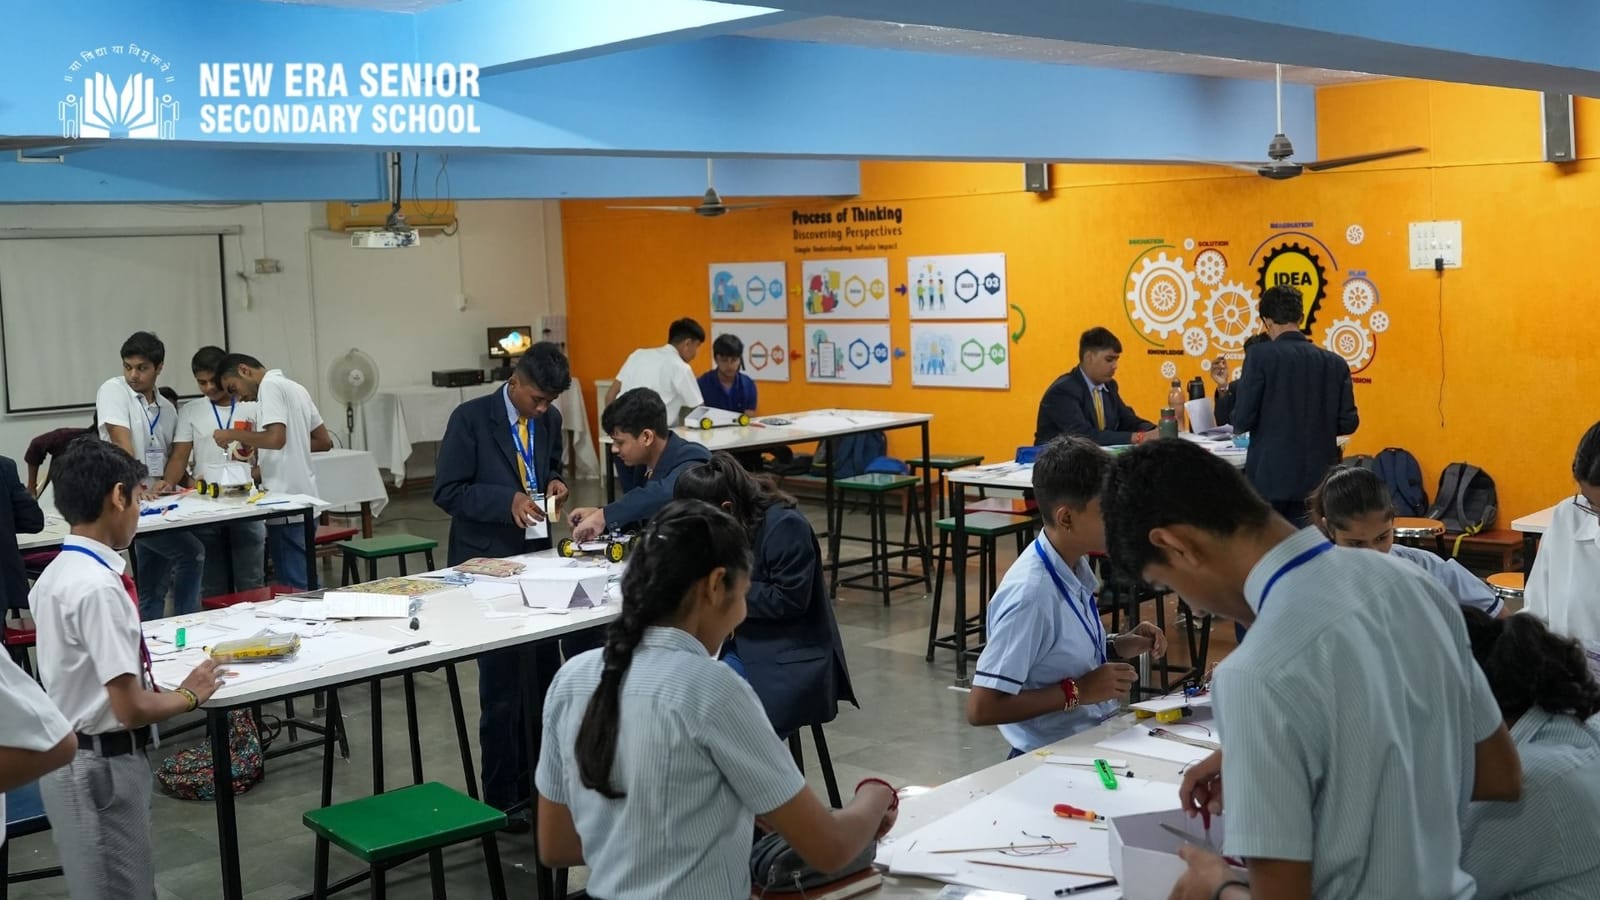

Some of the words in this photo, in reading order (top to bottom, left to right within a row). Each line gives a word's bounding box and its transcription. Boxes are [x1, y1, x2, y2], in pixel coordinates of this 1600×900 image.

[792, 209, 832, 225] Process
[836, 207, 848, 223] of
[851, 206, 903, 224] Thinking
[793, 229, 842, 241] Discovering
[846, 225, 903, 240] Perspectives
[984, 277, 999, 289] 03
[1273, 272, 1313, 287] IDEA
[991, 348, 1005, 359] 04
